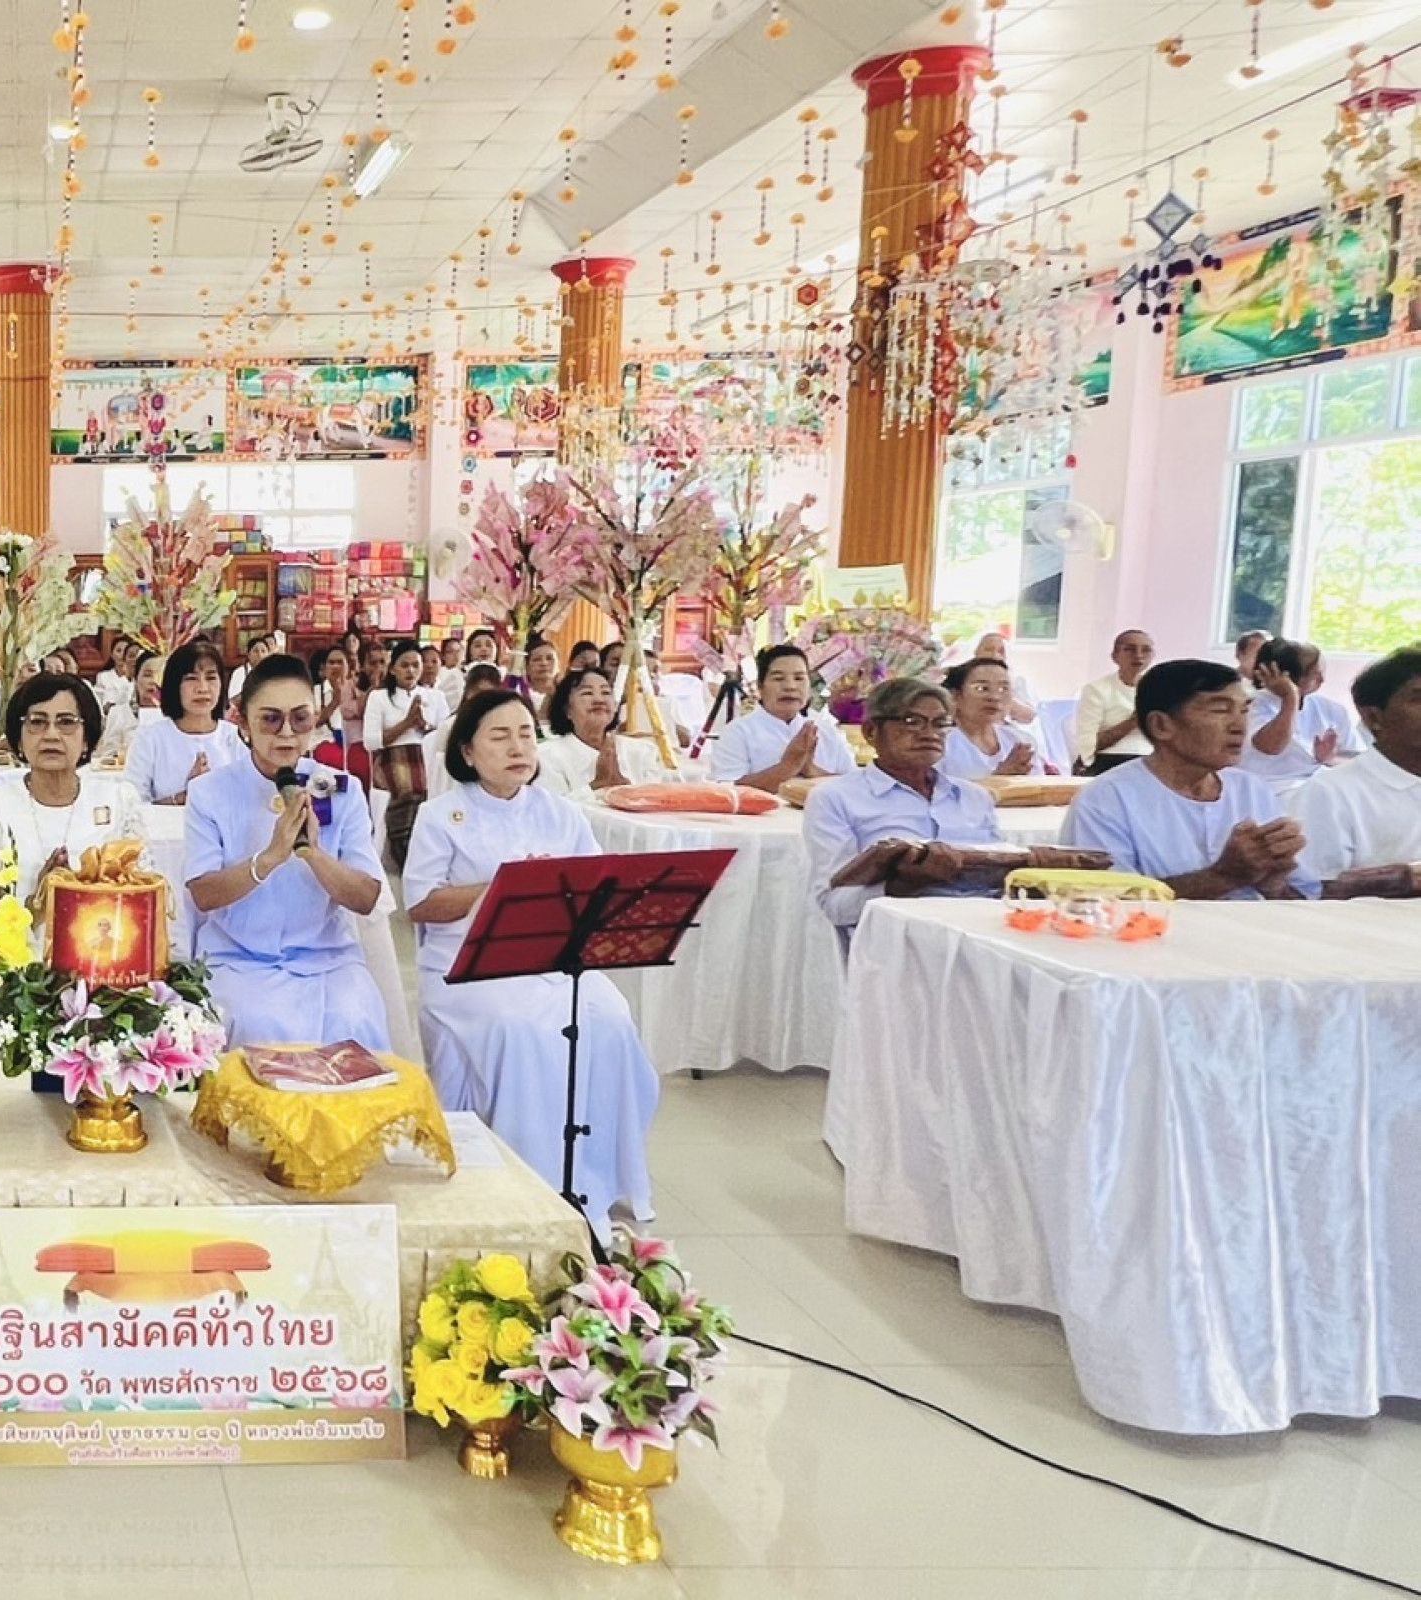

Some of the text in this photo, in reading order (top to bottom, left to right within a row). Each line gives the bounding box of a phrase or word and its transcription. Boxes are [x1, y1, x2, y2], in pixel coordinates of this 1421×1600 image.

[80, 1369, 111, 1395] วัด
[120, 1368, 259, 1404] พุทธศักราช
[269, 1364, 388, 1393] ๒๕๖๘
[228, 1420, 240, 1440] ปี
